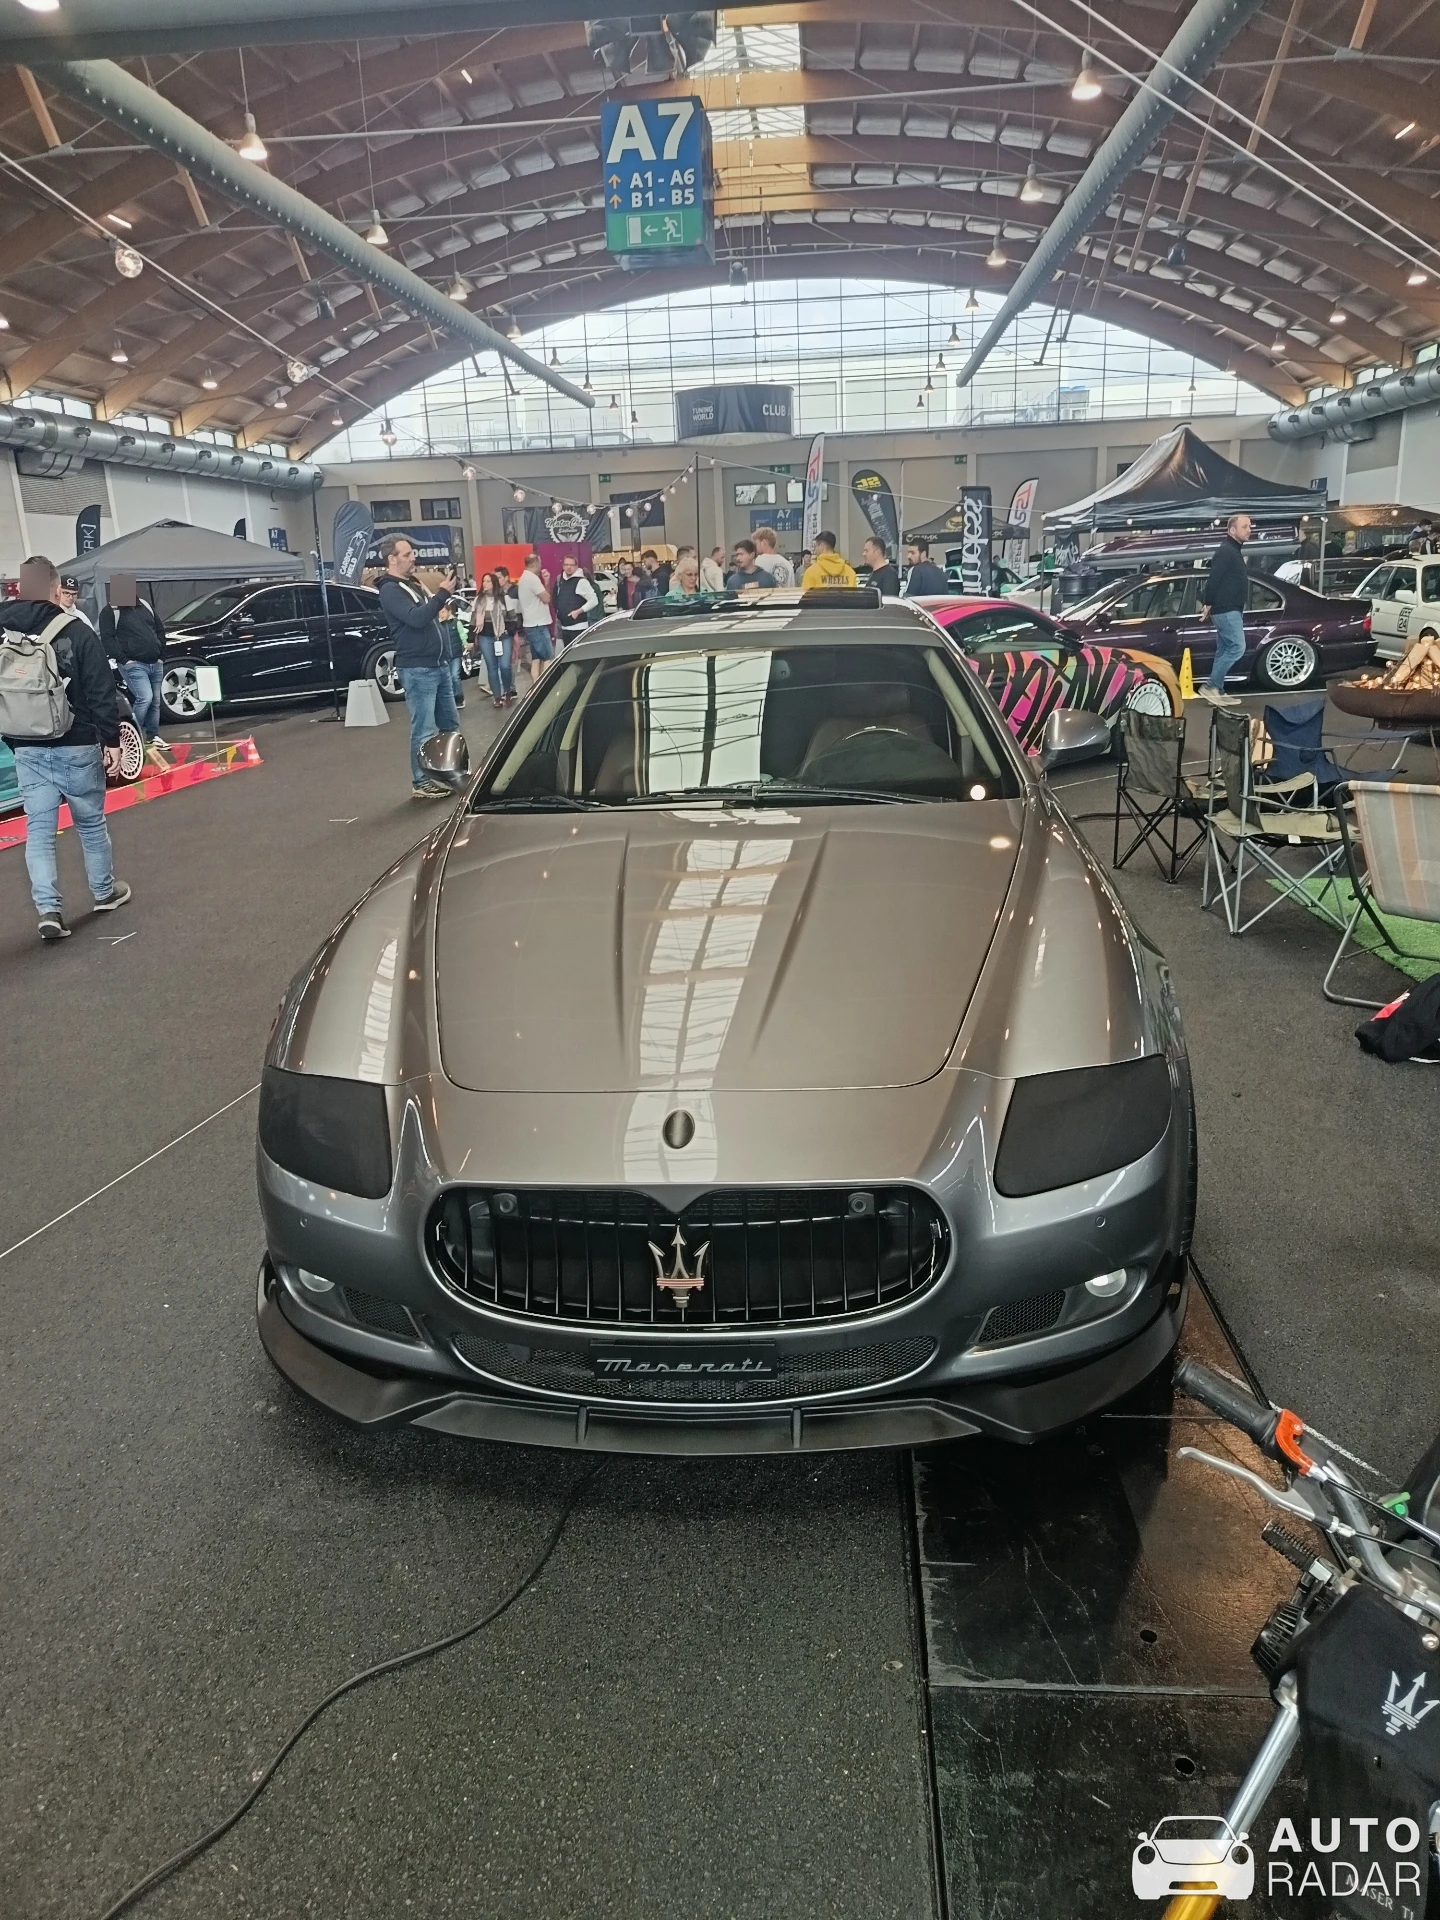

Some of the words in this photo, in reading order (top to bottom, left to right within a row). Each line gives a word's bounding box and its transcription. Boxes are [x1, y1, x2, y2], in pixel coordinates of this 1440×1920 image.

[606, 101, 695, 164] A7
[630, 171, 653, 189] A1
[670, 168, 695, 186] A6
[631, 191, 654, 208] B1
[671, 188, 695, 205] B5
[692, 405, 714, 413] TUNING
[692, 412, 714, 421] WORLD
[762, 404, 786, 416] CLUB
[777, 509, 792, 519] A7
[81, 523, 97, 554] RK]
[340, 547, 355, 575] CARBON
[346, 557, 358, 578] HELD
[821, 574, 850, 585] WHEELS
